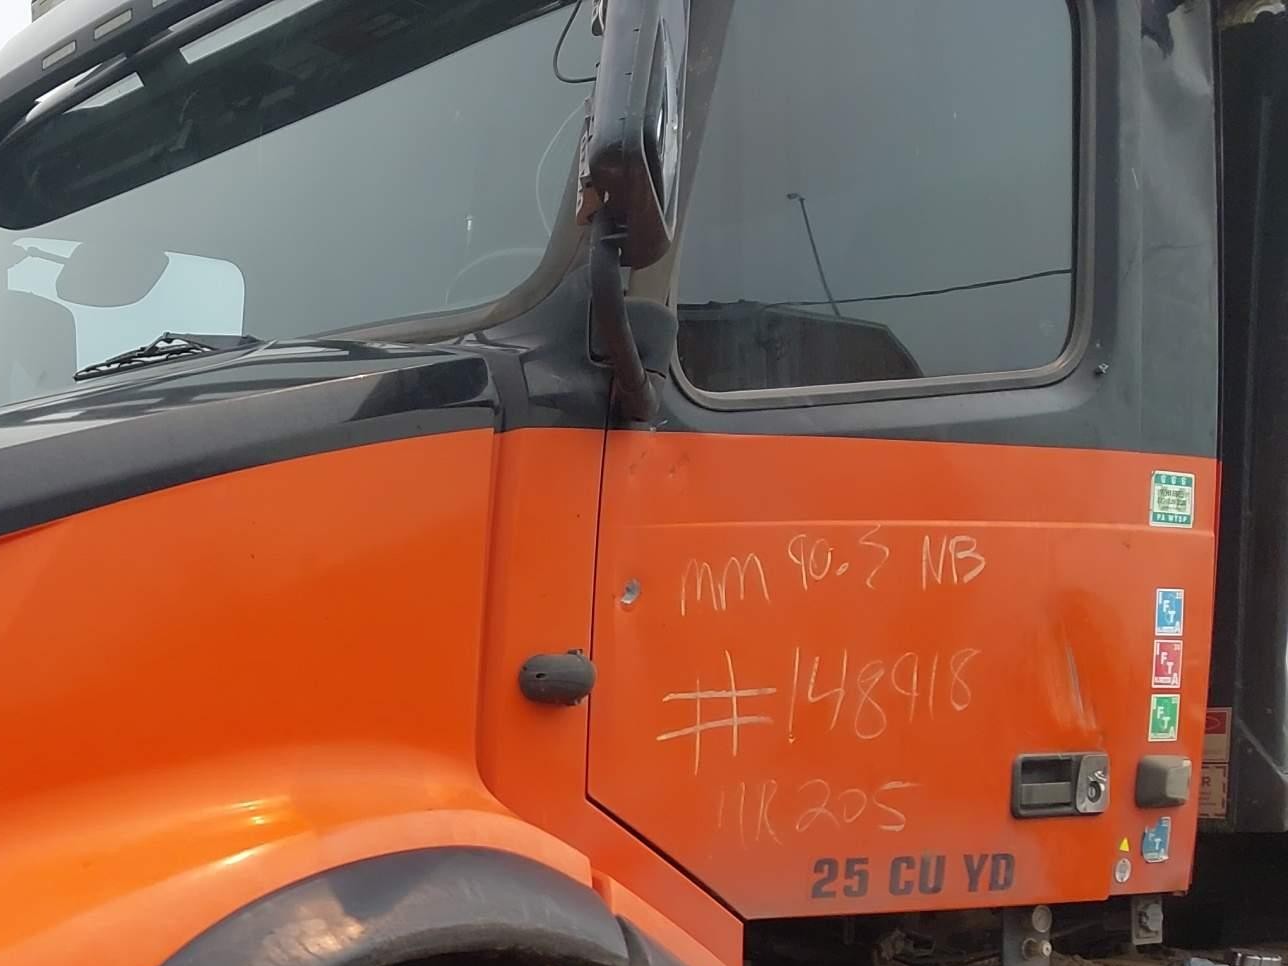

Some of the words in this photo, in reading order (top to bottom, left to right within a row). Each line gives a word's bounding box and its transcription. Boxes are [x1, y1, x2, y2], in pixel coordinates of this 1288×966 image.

[1156, 642, 1178, 686] IFTA
[811, 857, 870, 899] 25
[889, 855, 946, 896] CU
[964, 852, 1016, 893] YD
